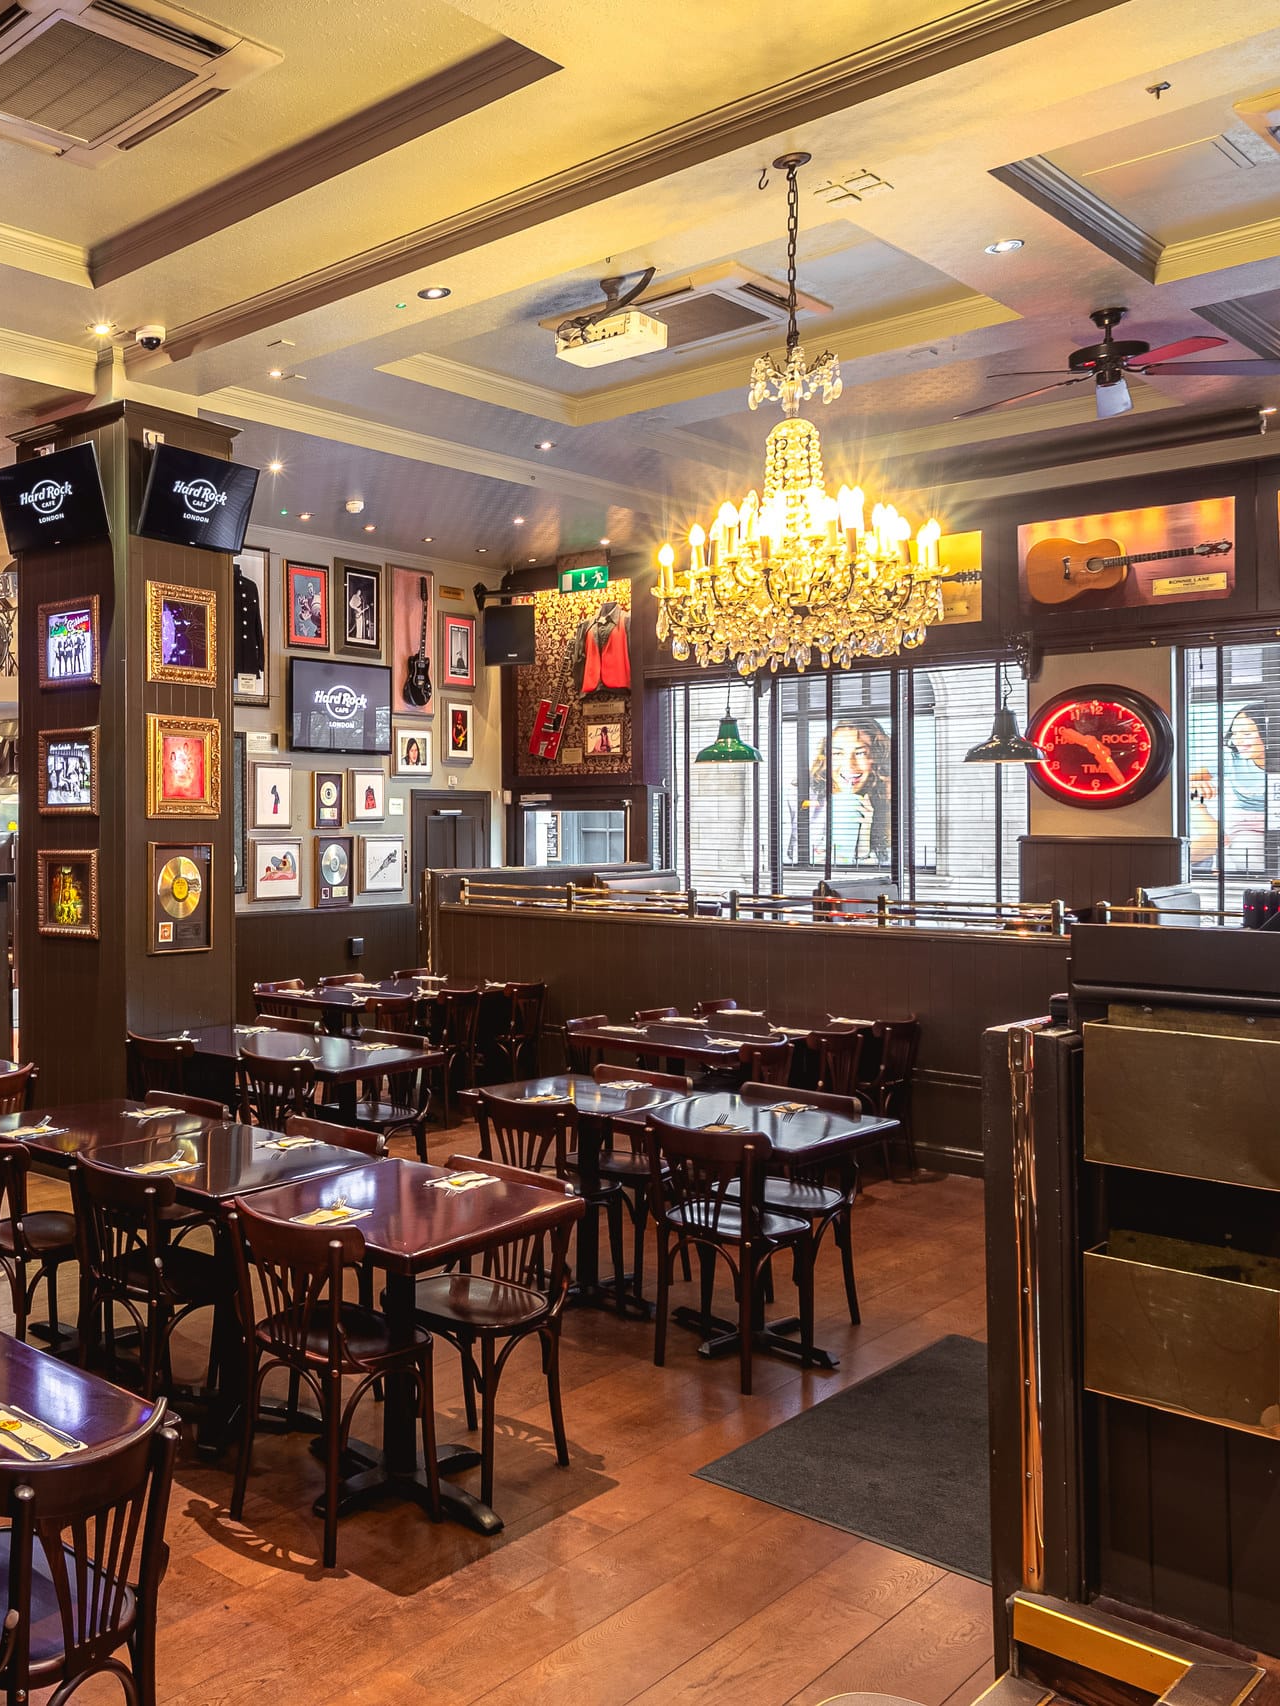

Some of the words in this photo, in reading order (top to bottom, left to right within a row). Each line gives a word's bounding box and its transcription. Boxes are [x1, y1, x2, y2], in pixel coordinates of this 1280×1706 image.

[20, 487, 46, 506] Hard
[46, 481, 73, 500] Rock
[172, 480, 203, 498] Hard
[200, 487, 227, 506] Rock
[41, 500, 56, 508] CAFE
[192, 499, 207, 508] CAFE
[38, 512, 65, 524] LONDON
[183, 512, 210, 524] LONDON
[314, 690, 342, 705] Hard
[341, 692, 368, 709] Rock
[334, 706, 350, 714] CAFE
[1090, 705, 1104, 716] 12
[329, 721, 354, 729] LONDON
[1101, 733, 1139, 744] ROCK
[1045, 742, 1055, 752] 9
[1138, 741, 1148, 752] 3
[1080, 763, 1108, 775] TIM
[1091, 778, 1101, 789] 6
